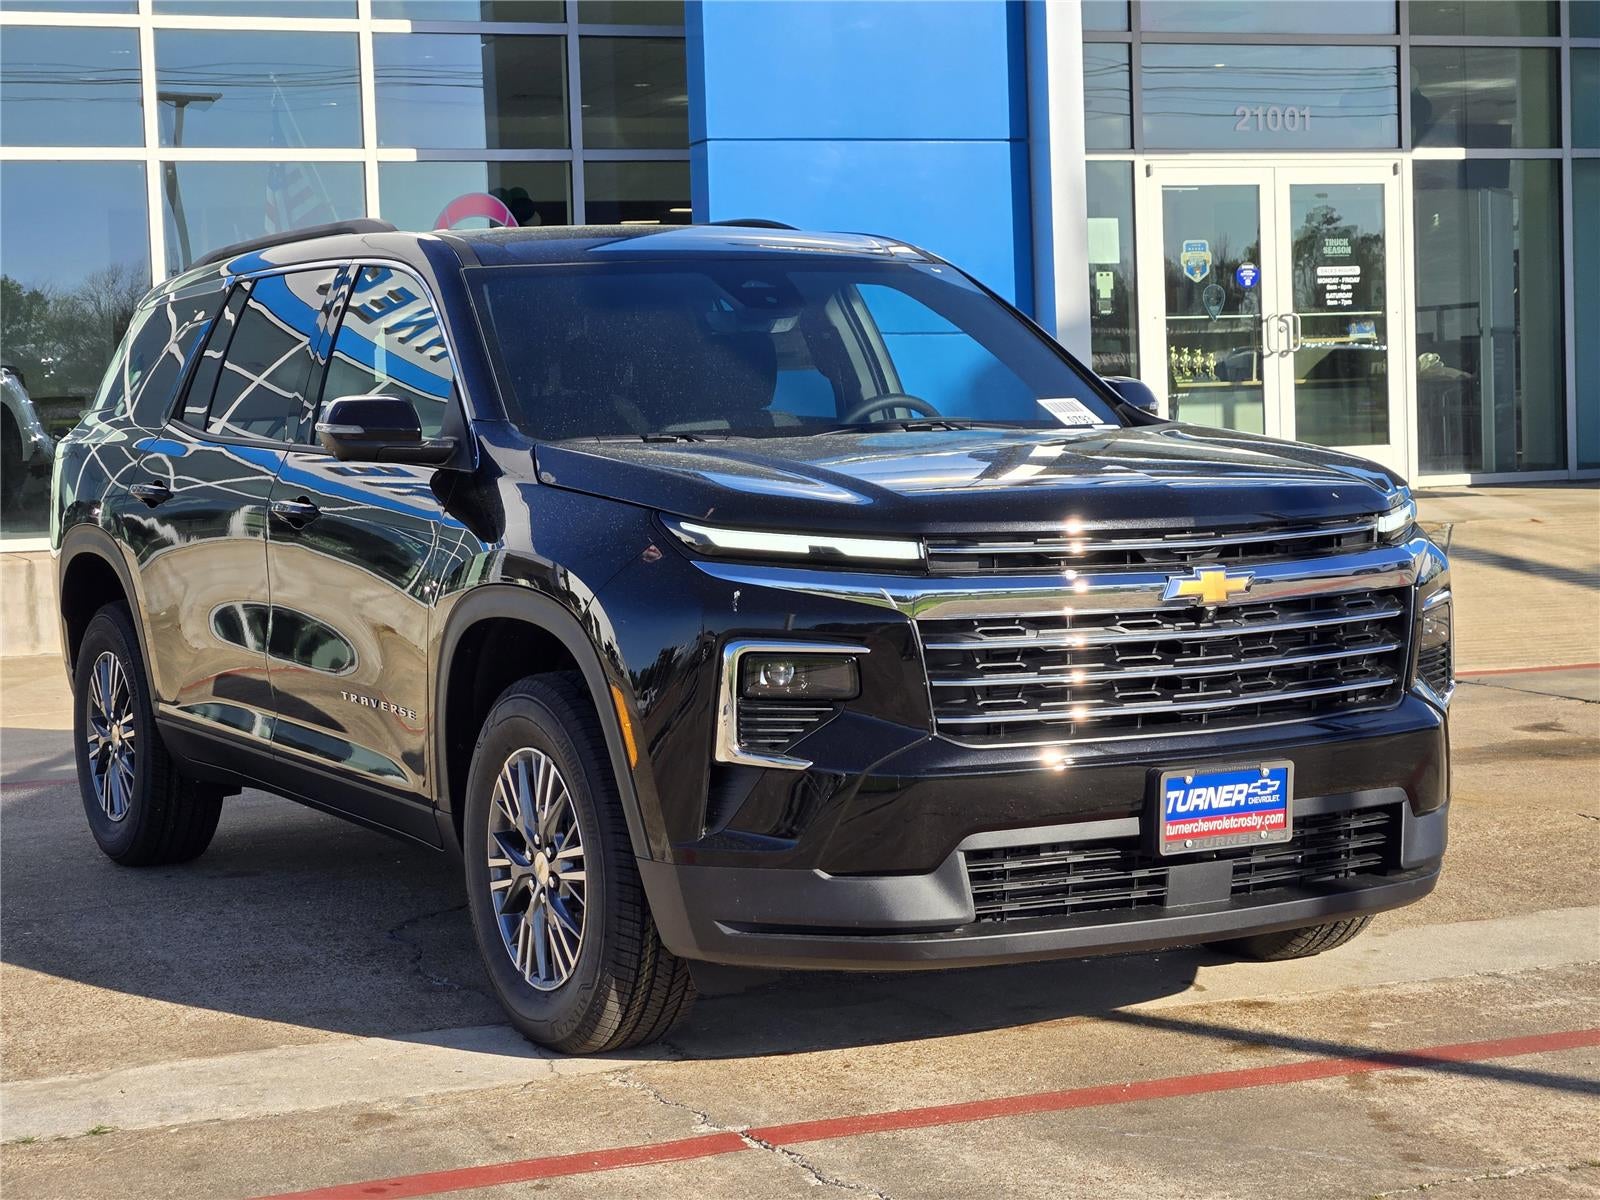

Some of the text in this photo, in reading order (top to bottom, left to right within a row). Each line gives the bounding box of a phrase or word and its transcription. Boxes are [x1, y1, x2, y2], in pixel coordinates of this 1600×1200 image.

[1234, 105, 1311, 132] 21001
[1323, 246, 1352, 254] SEASON
[1324, 238, 1349, 246] TRUCK
[340, 690, 417, 721] TRAVERSE
[1166, 783, 1249, 814] TURNER
[1248, 794, 1281, 805] CHEVROLET
[1166, 812, 1284, 836] turnerchevroletcrosby.com
